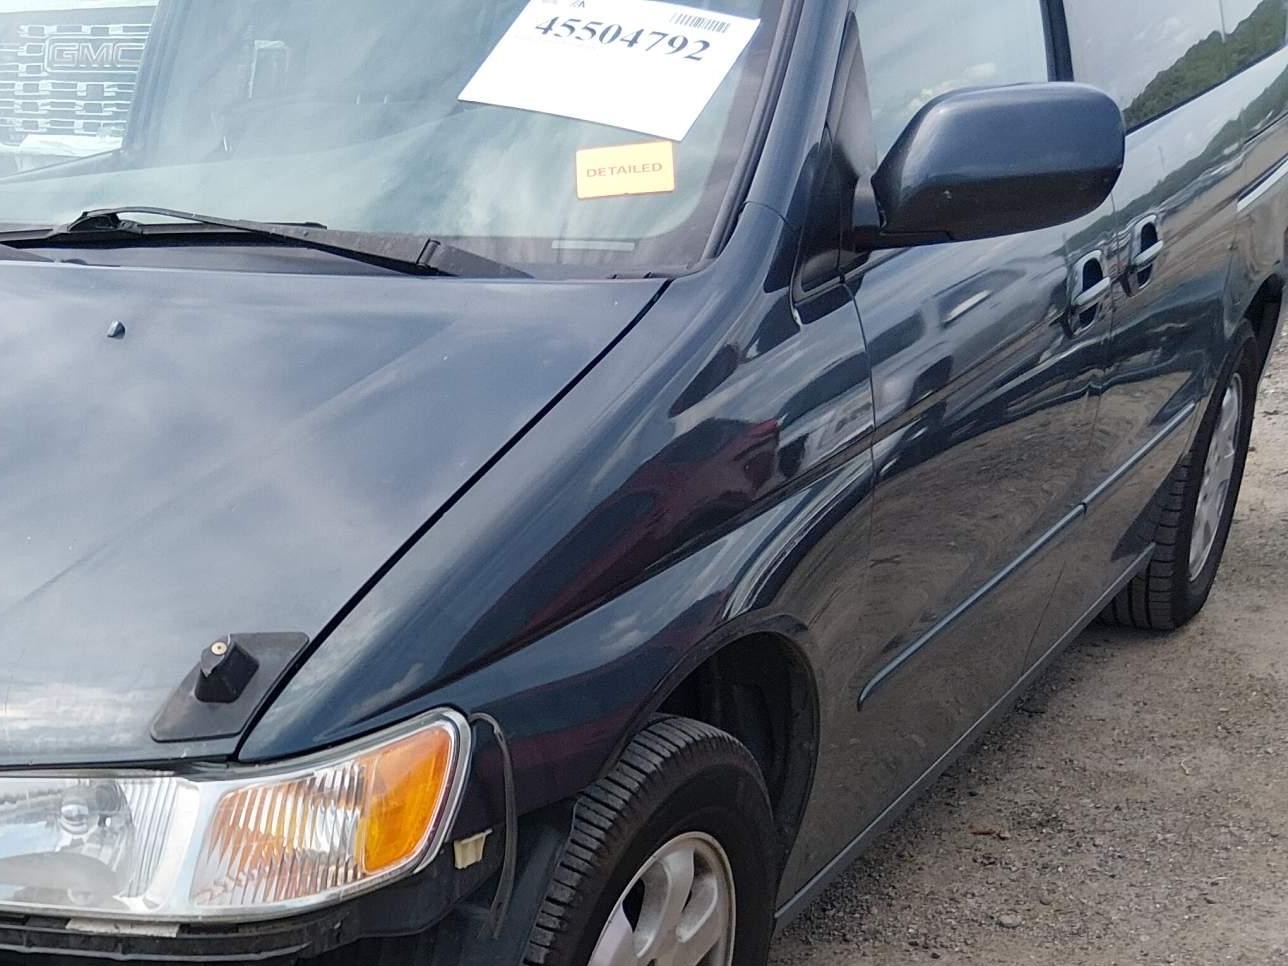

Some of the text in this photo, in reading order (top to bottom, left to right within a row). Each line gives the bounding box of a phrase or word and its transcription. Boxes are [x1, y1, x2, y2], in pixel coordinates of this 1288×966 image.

[535, 16, 711, 61] 45504792
[49, 42, 145, 67] GMC
[585, 162, 664, 178] DETAILED
